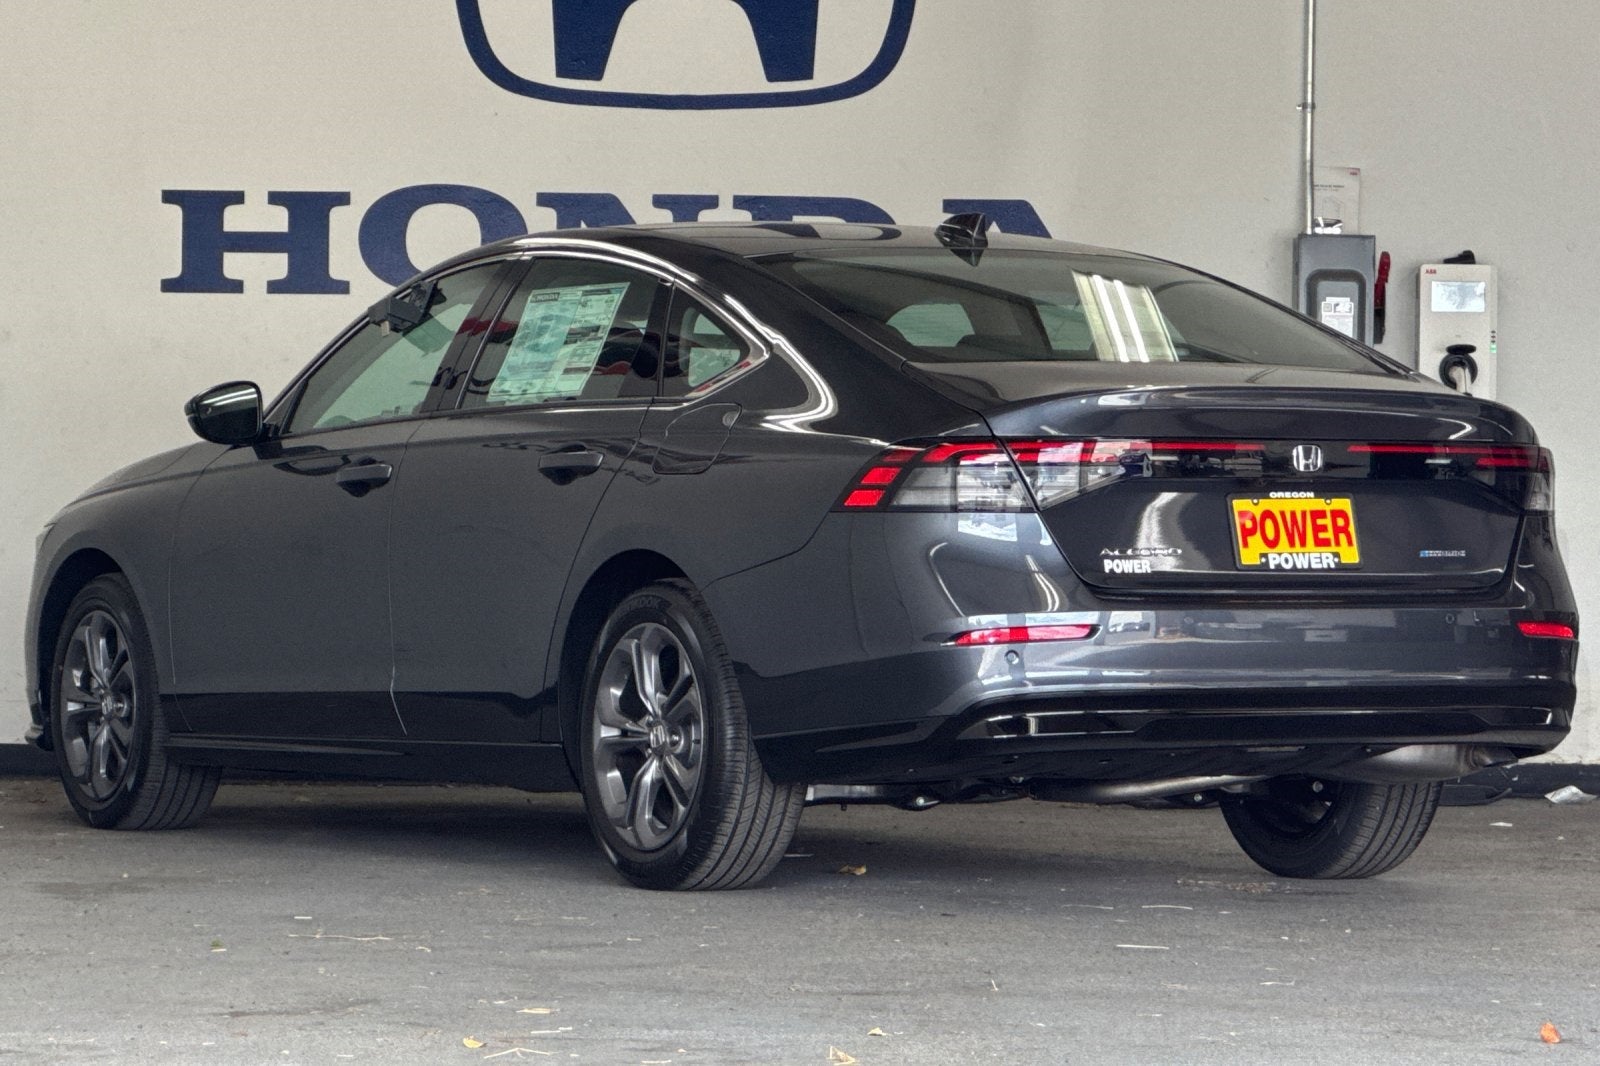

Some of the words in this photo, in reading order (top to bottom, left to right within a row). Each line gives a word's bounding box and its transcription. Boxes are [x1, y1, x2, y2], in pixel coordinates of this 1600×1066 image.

[1268, 491, 1315, 499] OREGON
[1237, 509, 1354, 549] POWER
[1103, 559, 1152, 574] POWER
[1267, 552, 1336, 570] POWER
